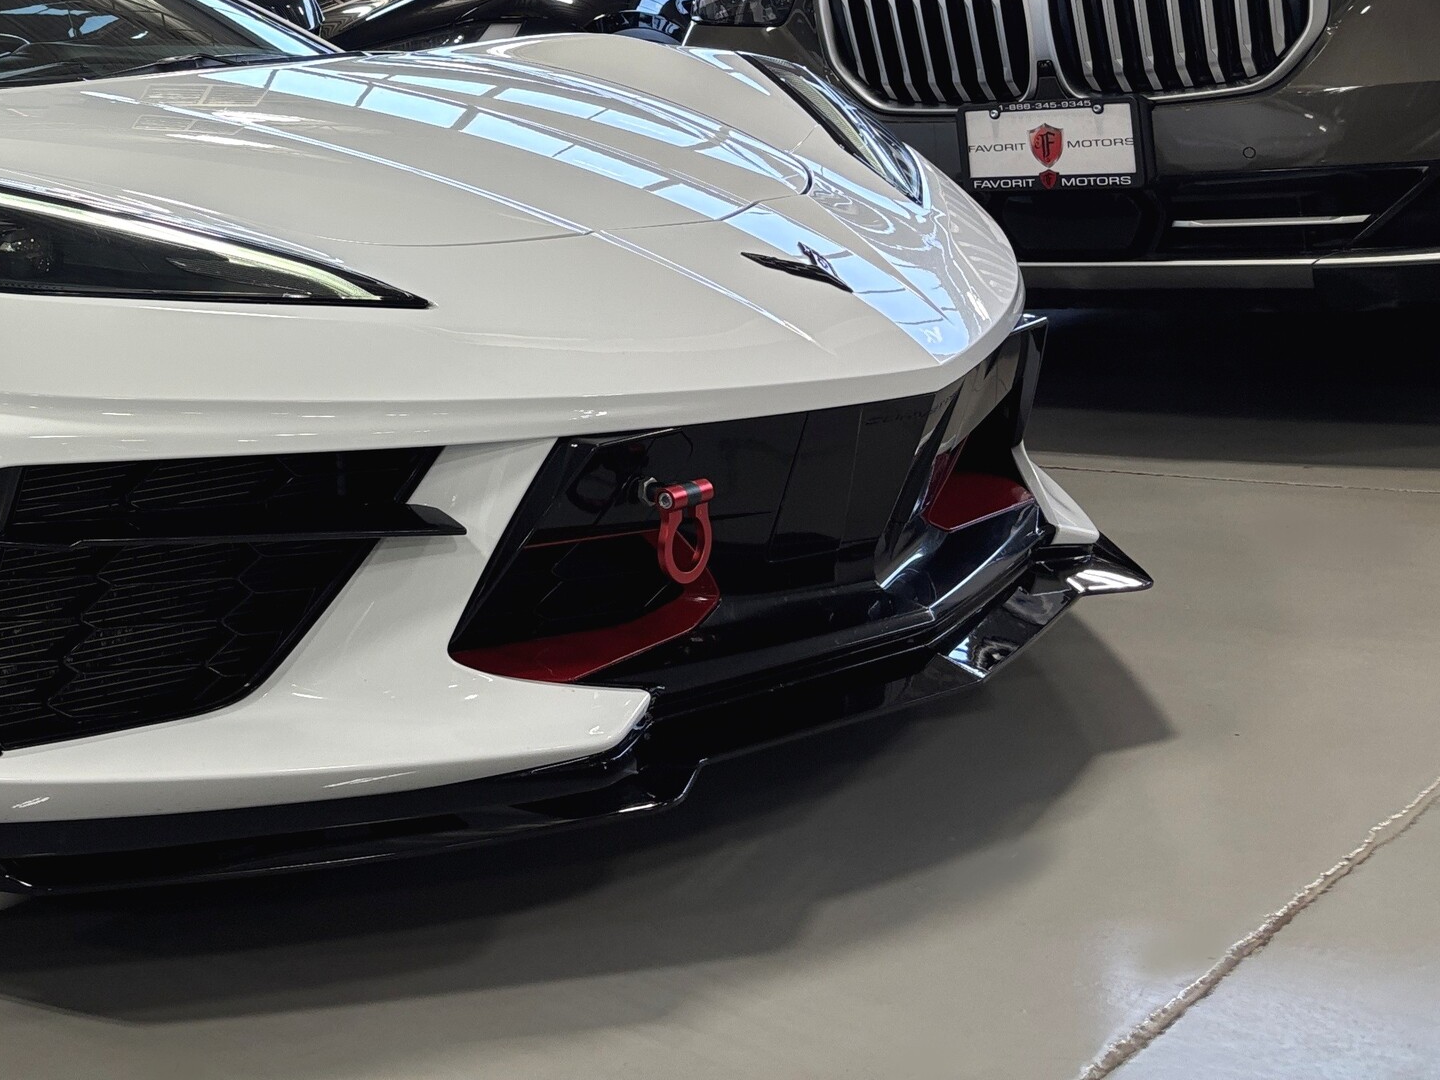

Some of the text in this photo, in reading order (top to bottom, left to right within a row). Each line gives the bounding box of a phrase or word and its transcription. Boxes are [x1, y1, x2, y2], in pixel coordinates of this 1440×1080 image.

[999, 100, 1091, 111] 1-888-345-9345
[968, 142, 1027, 153] FAVORIT
[1067, 137, 1135, 149] MOTORS
[973, 176, 1131, 189] FAVORIT MOTORS
